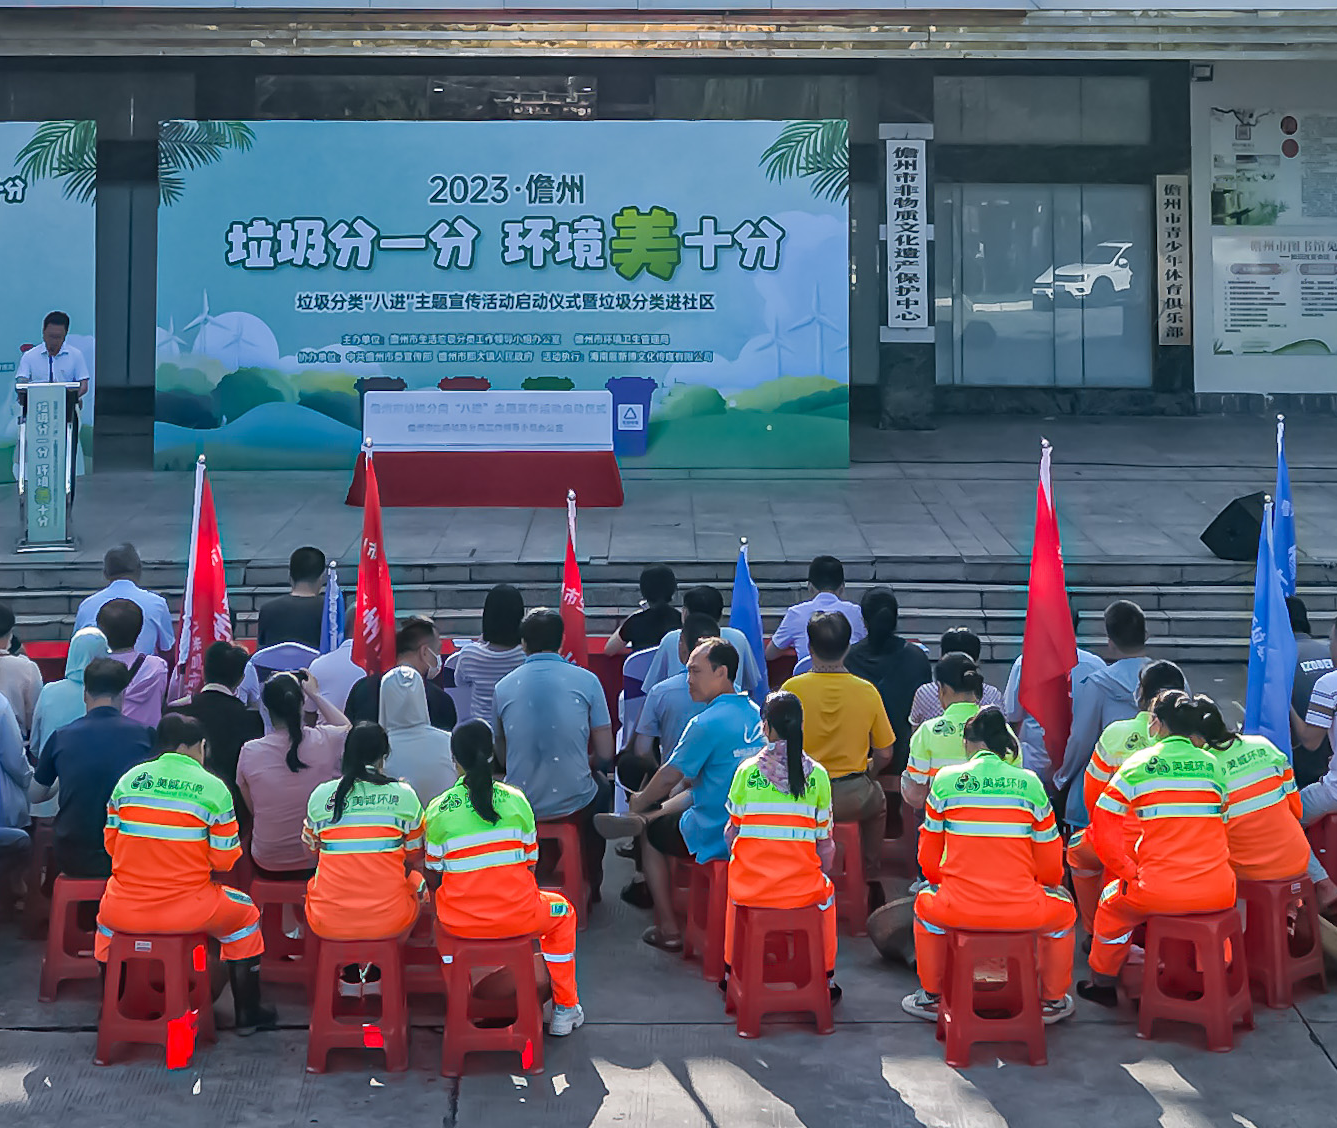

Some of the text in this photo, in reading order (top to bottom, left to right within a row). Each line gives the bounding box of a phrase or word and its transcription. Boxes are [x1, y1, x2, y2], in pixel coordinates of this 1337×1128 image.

[226, 205, 786, 280] 垃圾分一分 环境美十分
[428, 174, 585, 205] 2023·儋州
[892, 146, 921, 321] 儋州市非物质文化遗产保护中心
[1163, 183, 1184, 339] 儋州市青少年体育俱乐部
